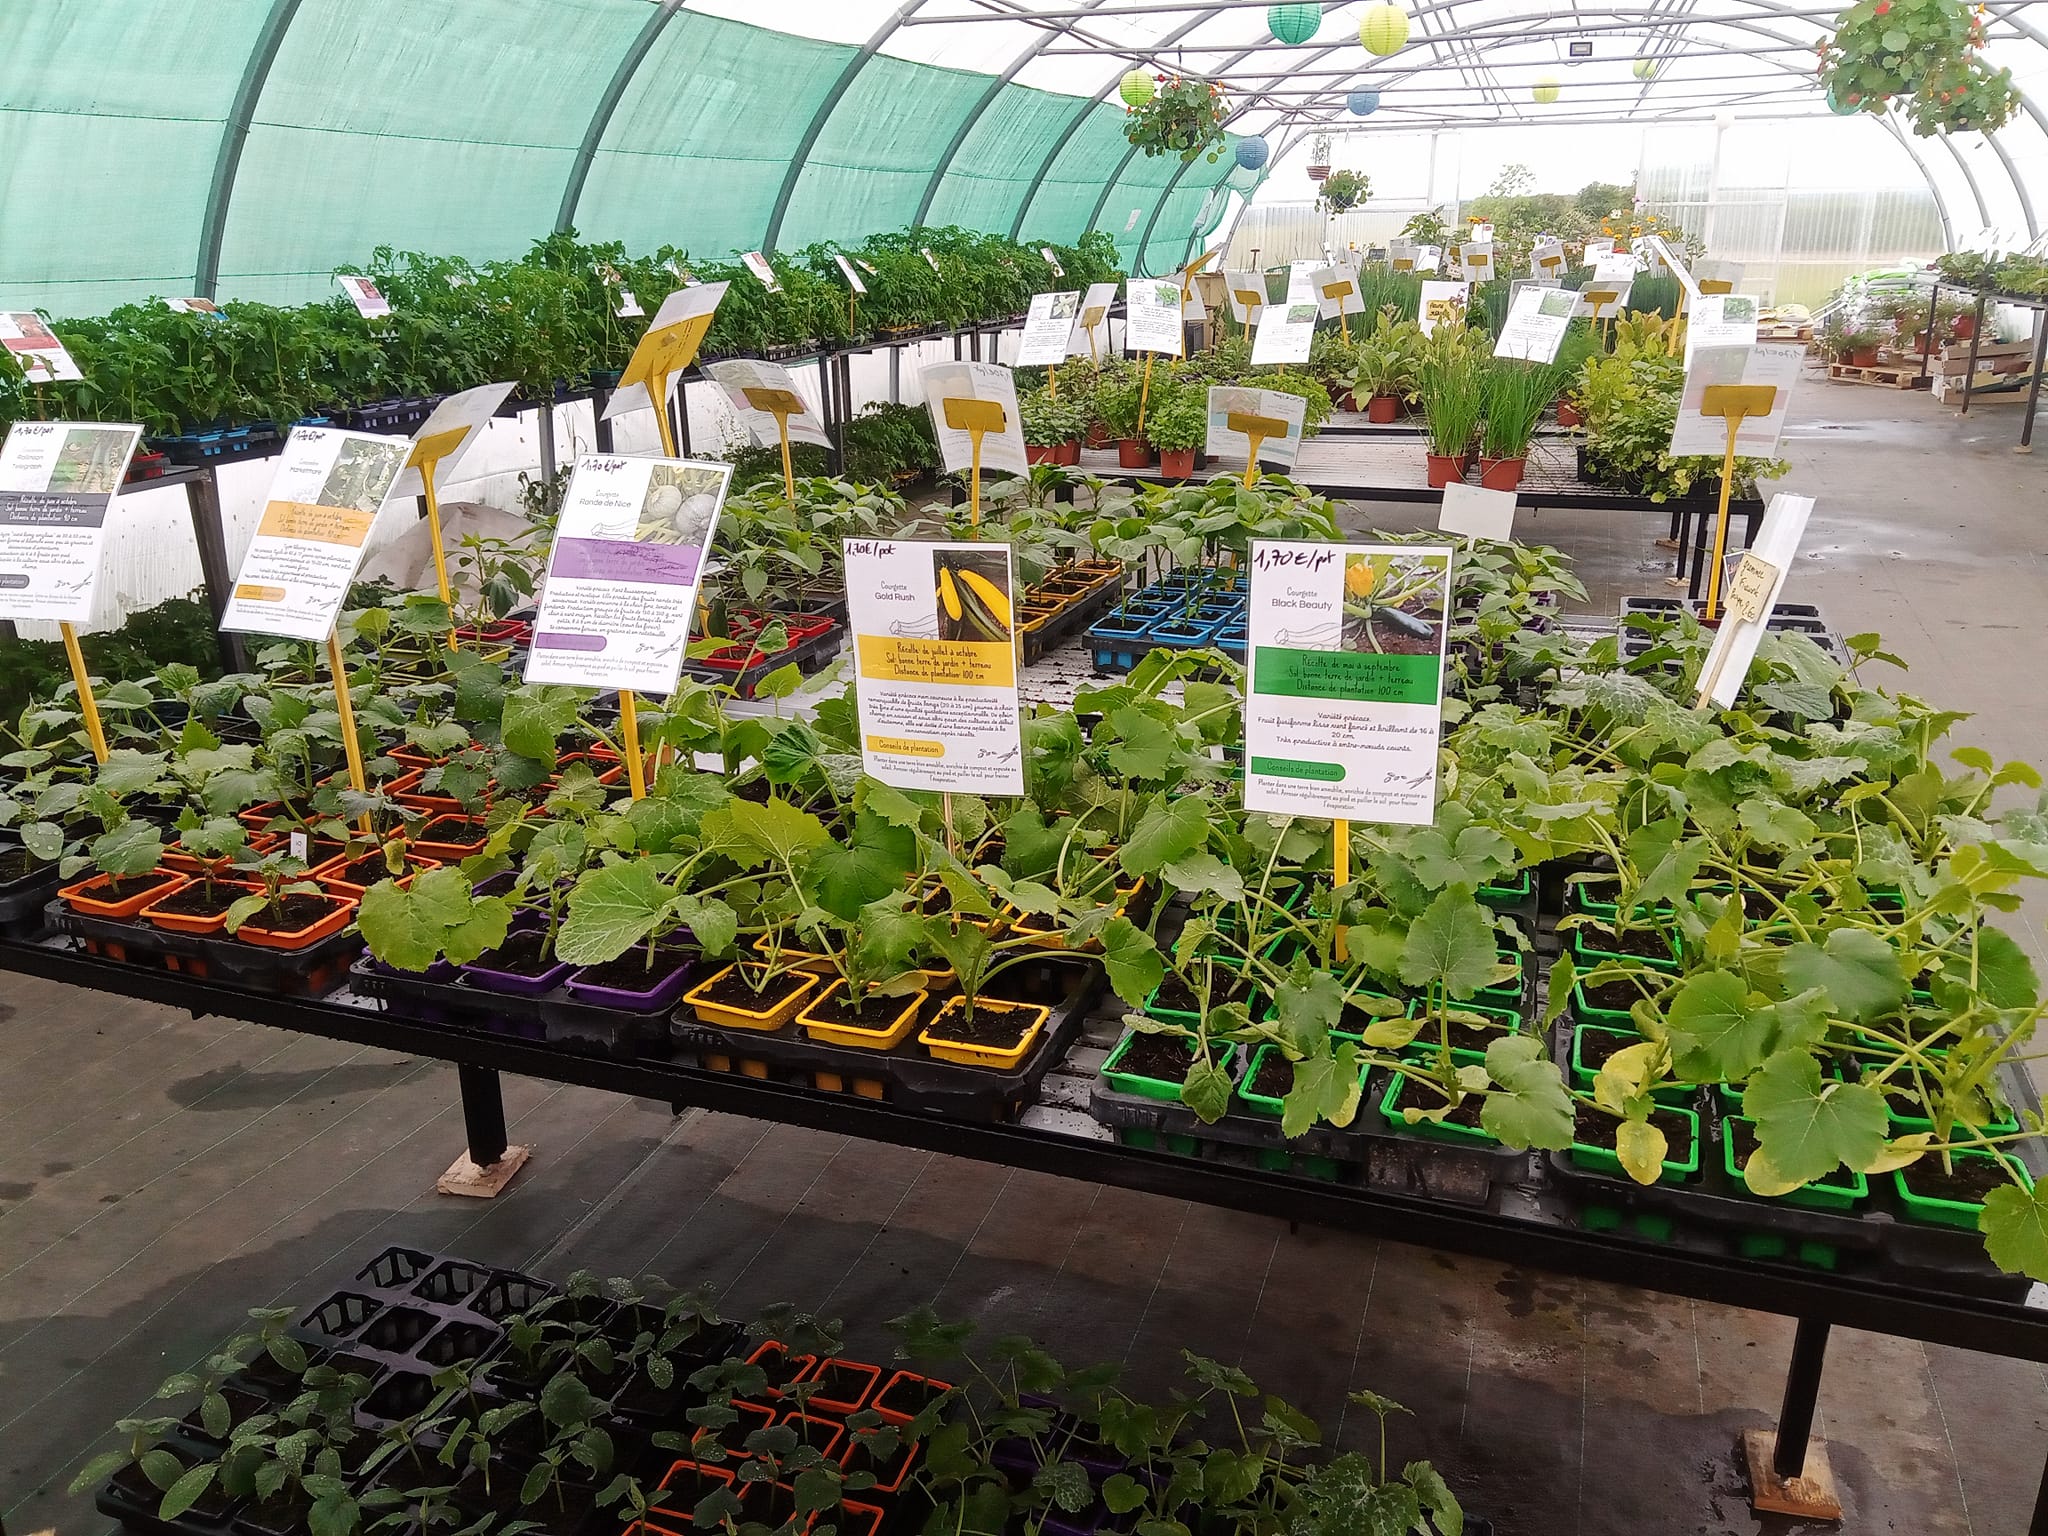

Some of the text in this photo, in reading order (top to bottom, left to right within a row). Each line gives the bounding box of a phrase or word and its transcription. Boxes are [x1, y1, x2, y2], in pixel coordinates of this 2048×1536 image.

[875, 592, 915, 601] Gold Rush
[1287, 586, 1318, 599] Courgette
[1272, 599, 1332, 611] Black Beauty
[923, 645, 929, 654] de
[956, 646, 977, 657] octobre
[898, 654, 914, 664] bonne
[917, 655, 931, 665] terre
[933, 658, 940, 666] de
[943, 657, 958, 670] jardin
[970, 659, 992, 669] terreau
[1332, 658, 1340, 669] de
[1364, 660, 1400, 676] septembre
[895, 664, 919, 676] Distance
[922, 666, 928, 676] de
[931, 667, 959, 682] plantation
[963, 670, 973, 679] 100
[1303, 667, 1320, 678] bonne
[1325, 669, 1341, 681] terre
[1344, 671, 1353, 681] de
[1356, 672, 1375, 686] jardin
[1388, 673, 1414, 685] terreau
[1297, 679, 1326, 691] Distance
[1329, 681, 1336, 692] de
[1340, 682, 1374, 698] plantation
[1378, 686, 1391, 696] 100
[1318, 712, 1342, 720] Variété
[1276, 716, 1311, 728] fusiforme
[1312, 720, 1329, 728] lisse
[1348, 722, 1368, 733] foncé
[1377, 724, 1407, 732] brillant
[879, 740, 938, 753] Conseils de plantation
[1294, 738, 1330, 746] productive
[1267, 761, 1337, 776] Conseils de plantation
